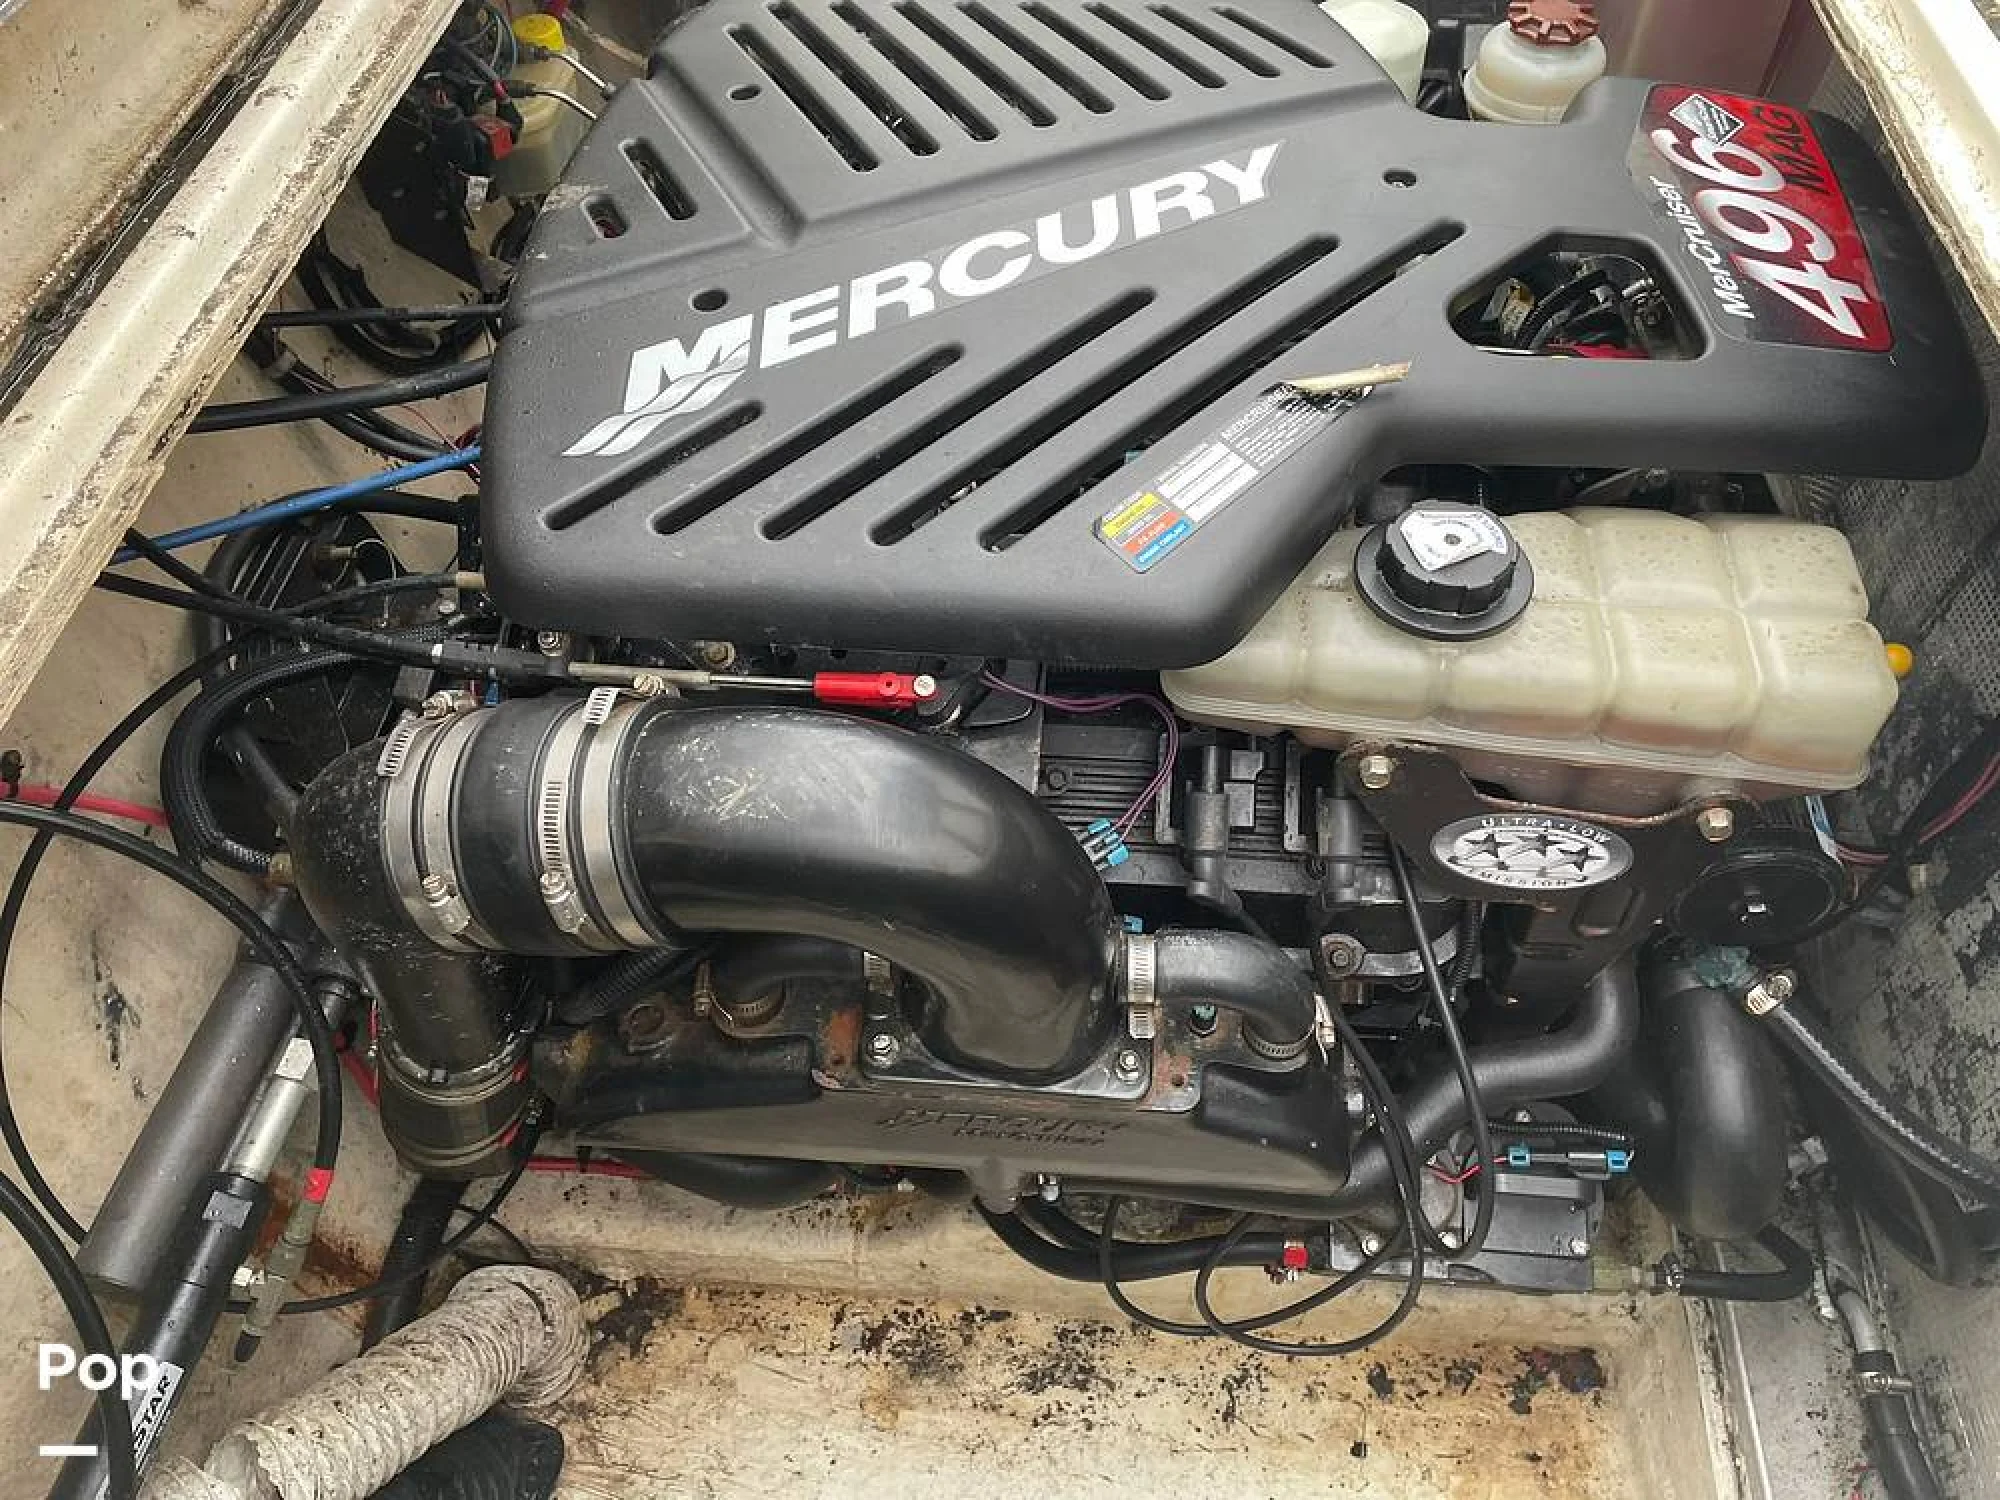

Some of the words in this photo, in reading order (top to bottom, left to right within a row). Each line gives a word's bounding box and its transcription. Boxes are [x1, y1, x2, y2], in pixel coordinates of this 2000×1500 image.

[1650, 128, 1869, 339] 496
[1753, 104, 1832, 196] MAG
[623, 142, 1284, 414] MERCURY
[1649, 174, 1755, 319] MerCruiser
